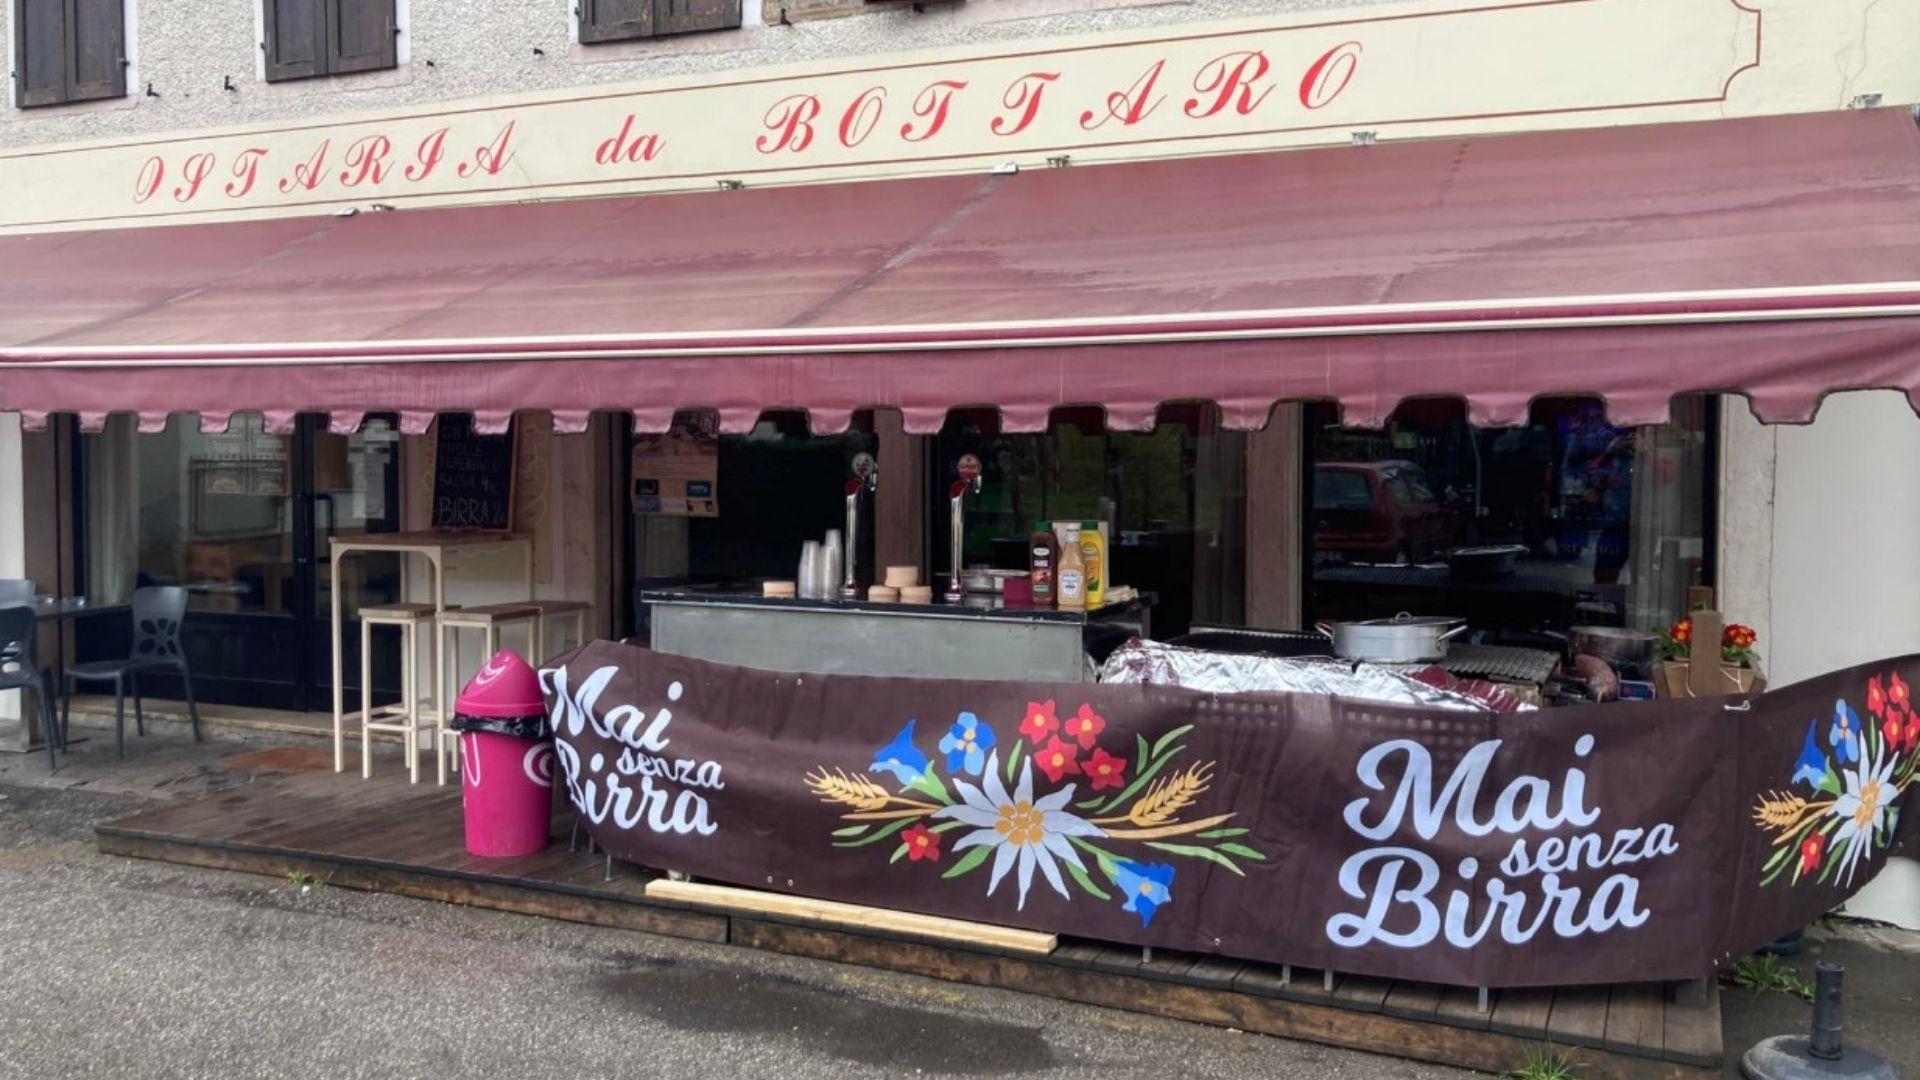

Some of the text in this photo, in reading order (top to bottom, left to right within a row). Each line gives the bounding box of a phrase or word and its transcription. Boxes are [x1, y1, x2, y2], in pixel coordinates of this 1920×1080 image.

[134, 41, 1363, 204] OSTARIA da BOTTARO
[438, 496, 489, 524] BIRRA
[537, 664, 683, 751] Mai
[617, 747, 725, 789] senza
[1343, 734, 1600, 840] Mai
[1500, 823, 1679, 877] senza
[1326, 846, 1650, 948] Birra
